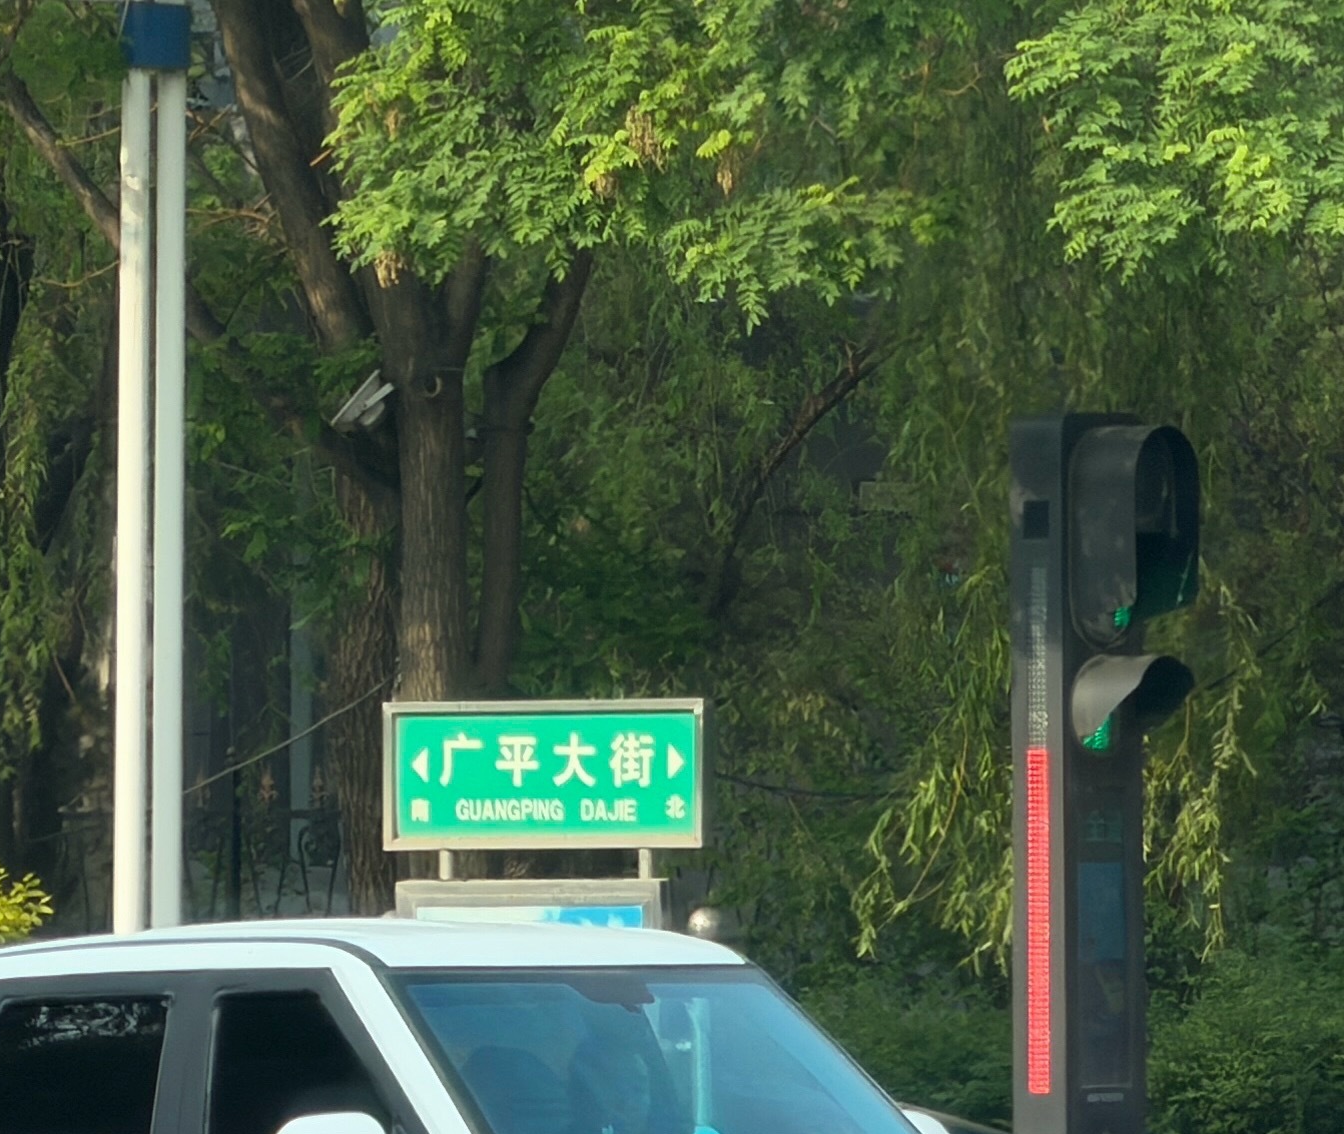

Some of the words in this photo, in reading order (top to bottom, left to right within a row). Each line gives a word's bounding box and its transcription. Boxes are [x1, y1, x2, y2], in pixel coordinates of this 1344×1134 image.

[439, 732, 655, 788] 广平大街
[455, 798, 564, 822] GUANGPING
[580, 798, 637, 822] DAJIE
[665, 794, 686, 819] 北
